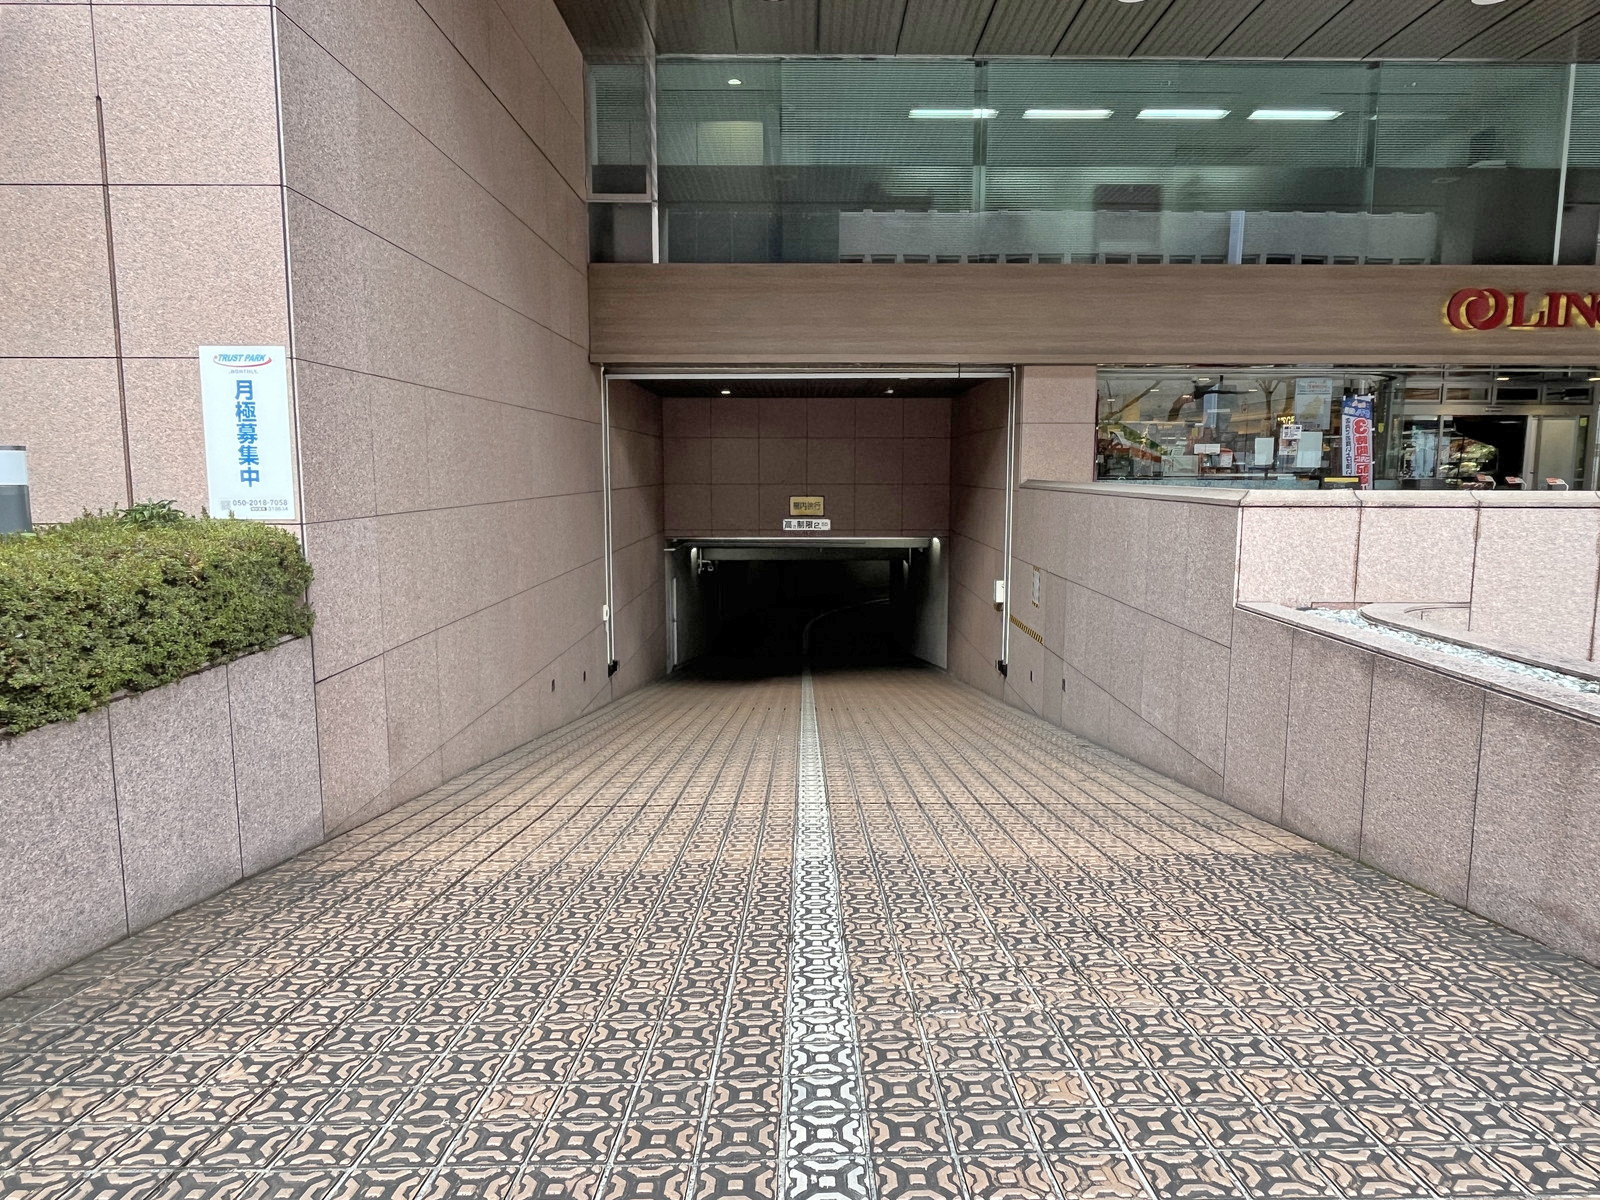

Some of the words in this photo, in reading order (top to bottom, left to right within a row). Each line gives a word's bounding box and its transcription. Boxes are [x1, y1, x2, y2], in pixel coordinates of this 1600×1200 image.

[217, 353, 244, 362] TRUST
[244, 353, 266, 362] PARK
[235, 380, 260, 488] 月極募集中
